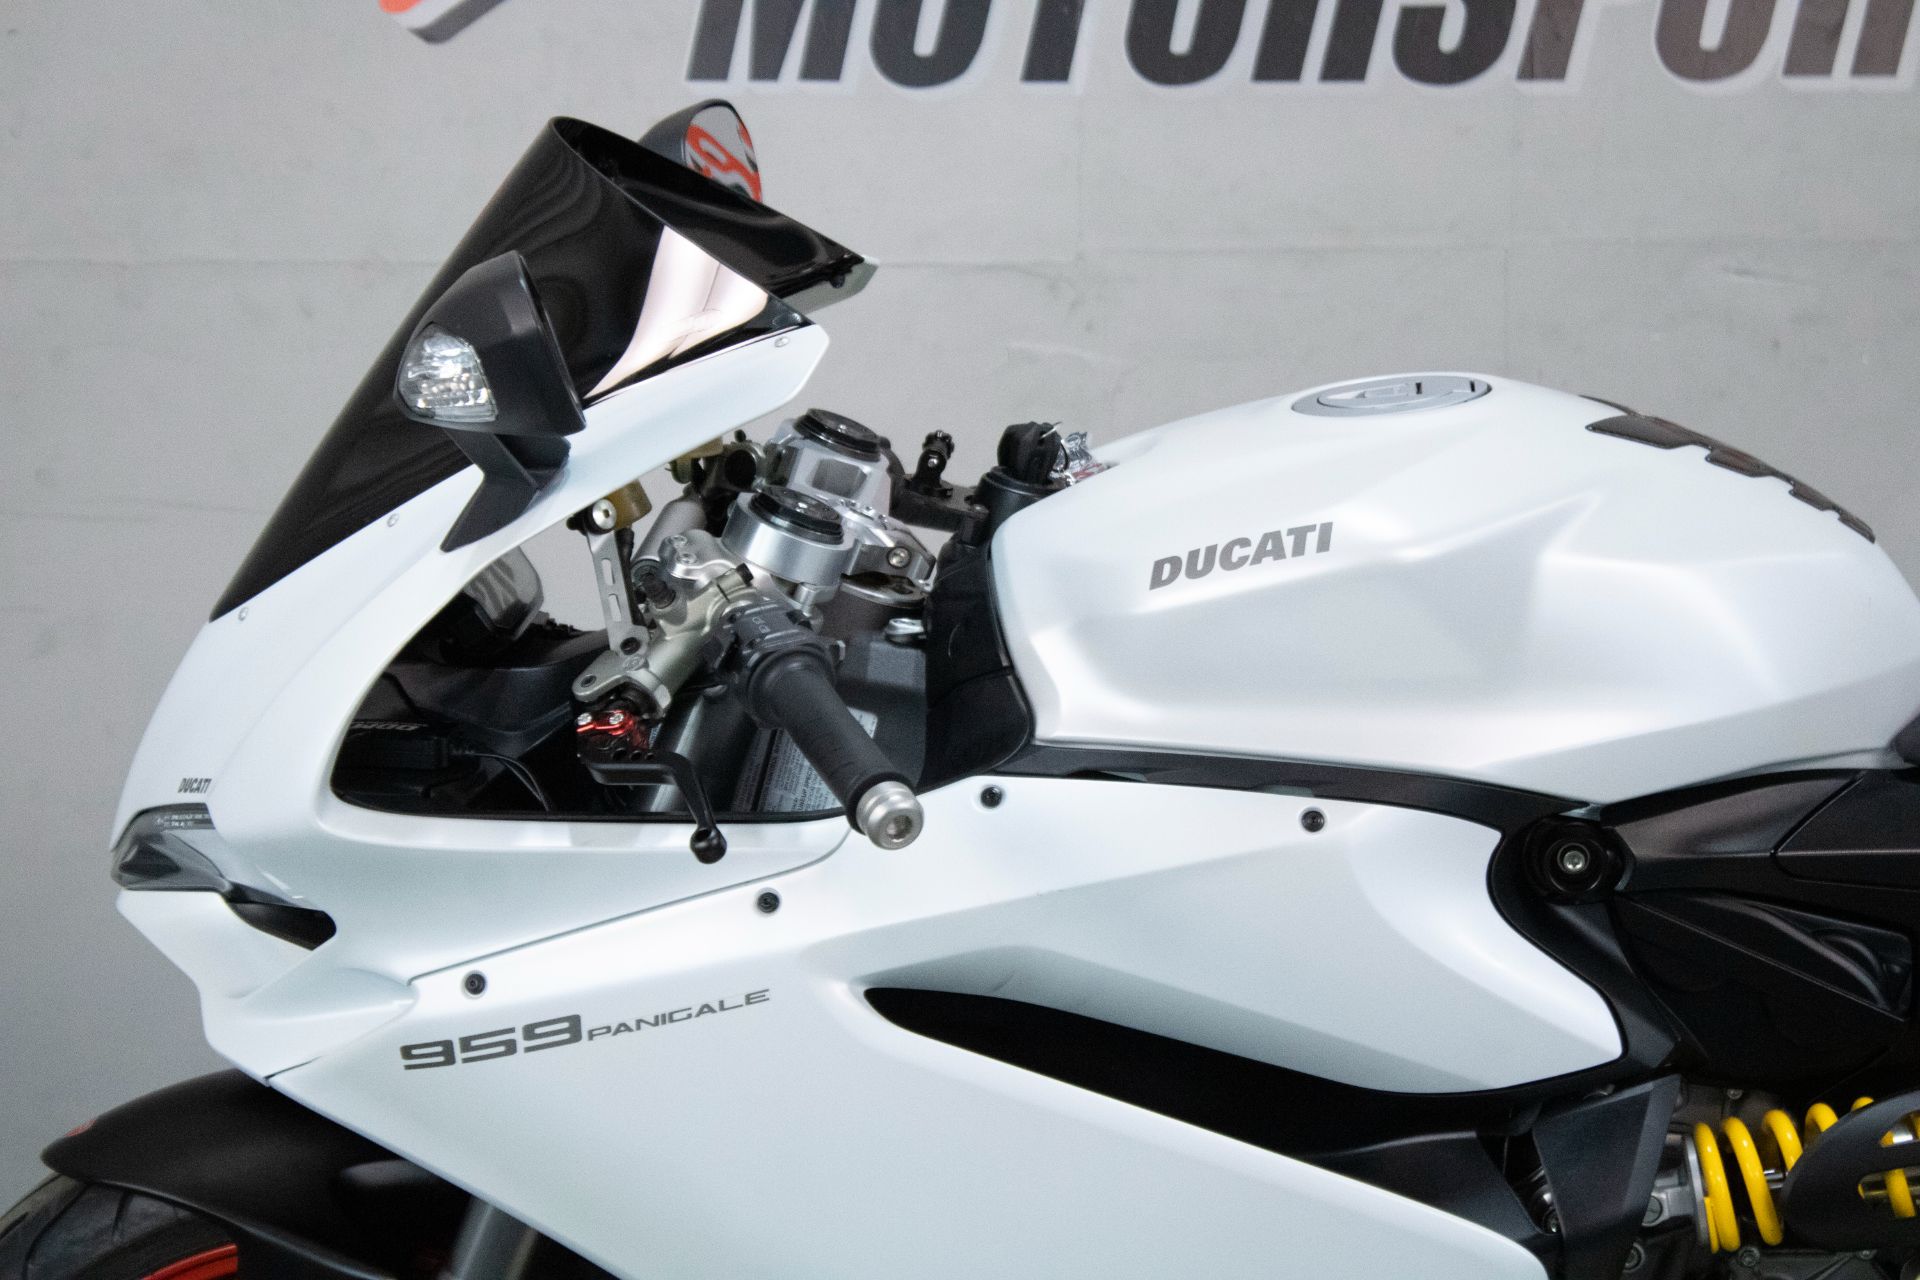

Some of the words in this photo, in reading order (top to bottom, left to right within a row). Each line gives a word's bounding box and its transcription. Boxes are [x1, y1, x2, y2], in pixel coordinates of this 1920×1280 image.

[1149, 522, 1333, 590] DUCATI
[177, 777, 212, 794] DUCATI
[400, 1013, 582, 1070] 959
[587, 988, 770, 1041] PANIGALE
